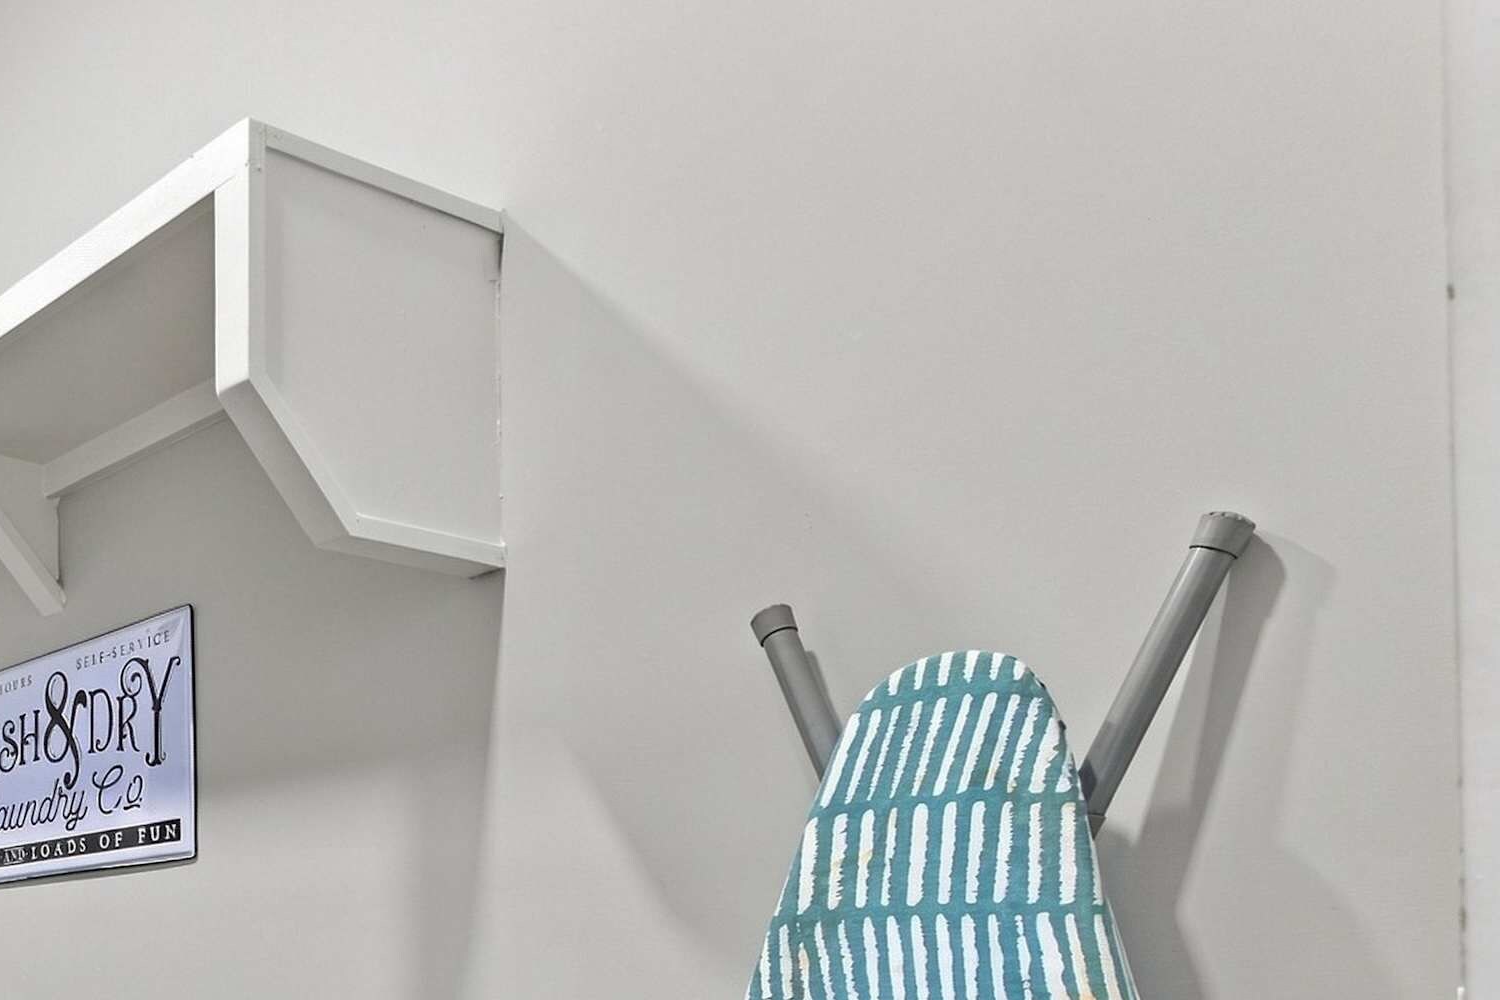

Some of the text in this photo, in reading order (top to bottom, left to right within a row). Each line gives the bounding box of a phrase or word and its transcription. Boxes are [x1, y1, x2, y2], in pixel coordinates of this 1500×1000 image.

[43, 671, 88, 790] &
[88, 656, 181, 767] DRY
[31, 838, 87, 860] LOADS
[99, 831, 123, 849] OF
[138, 824, 177, 844] FUN
